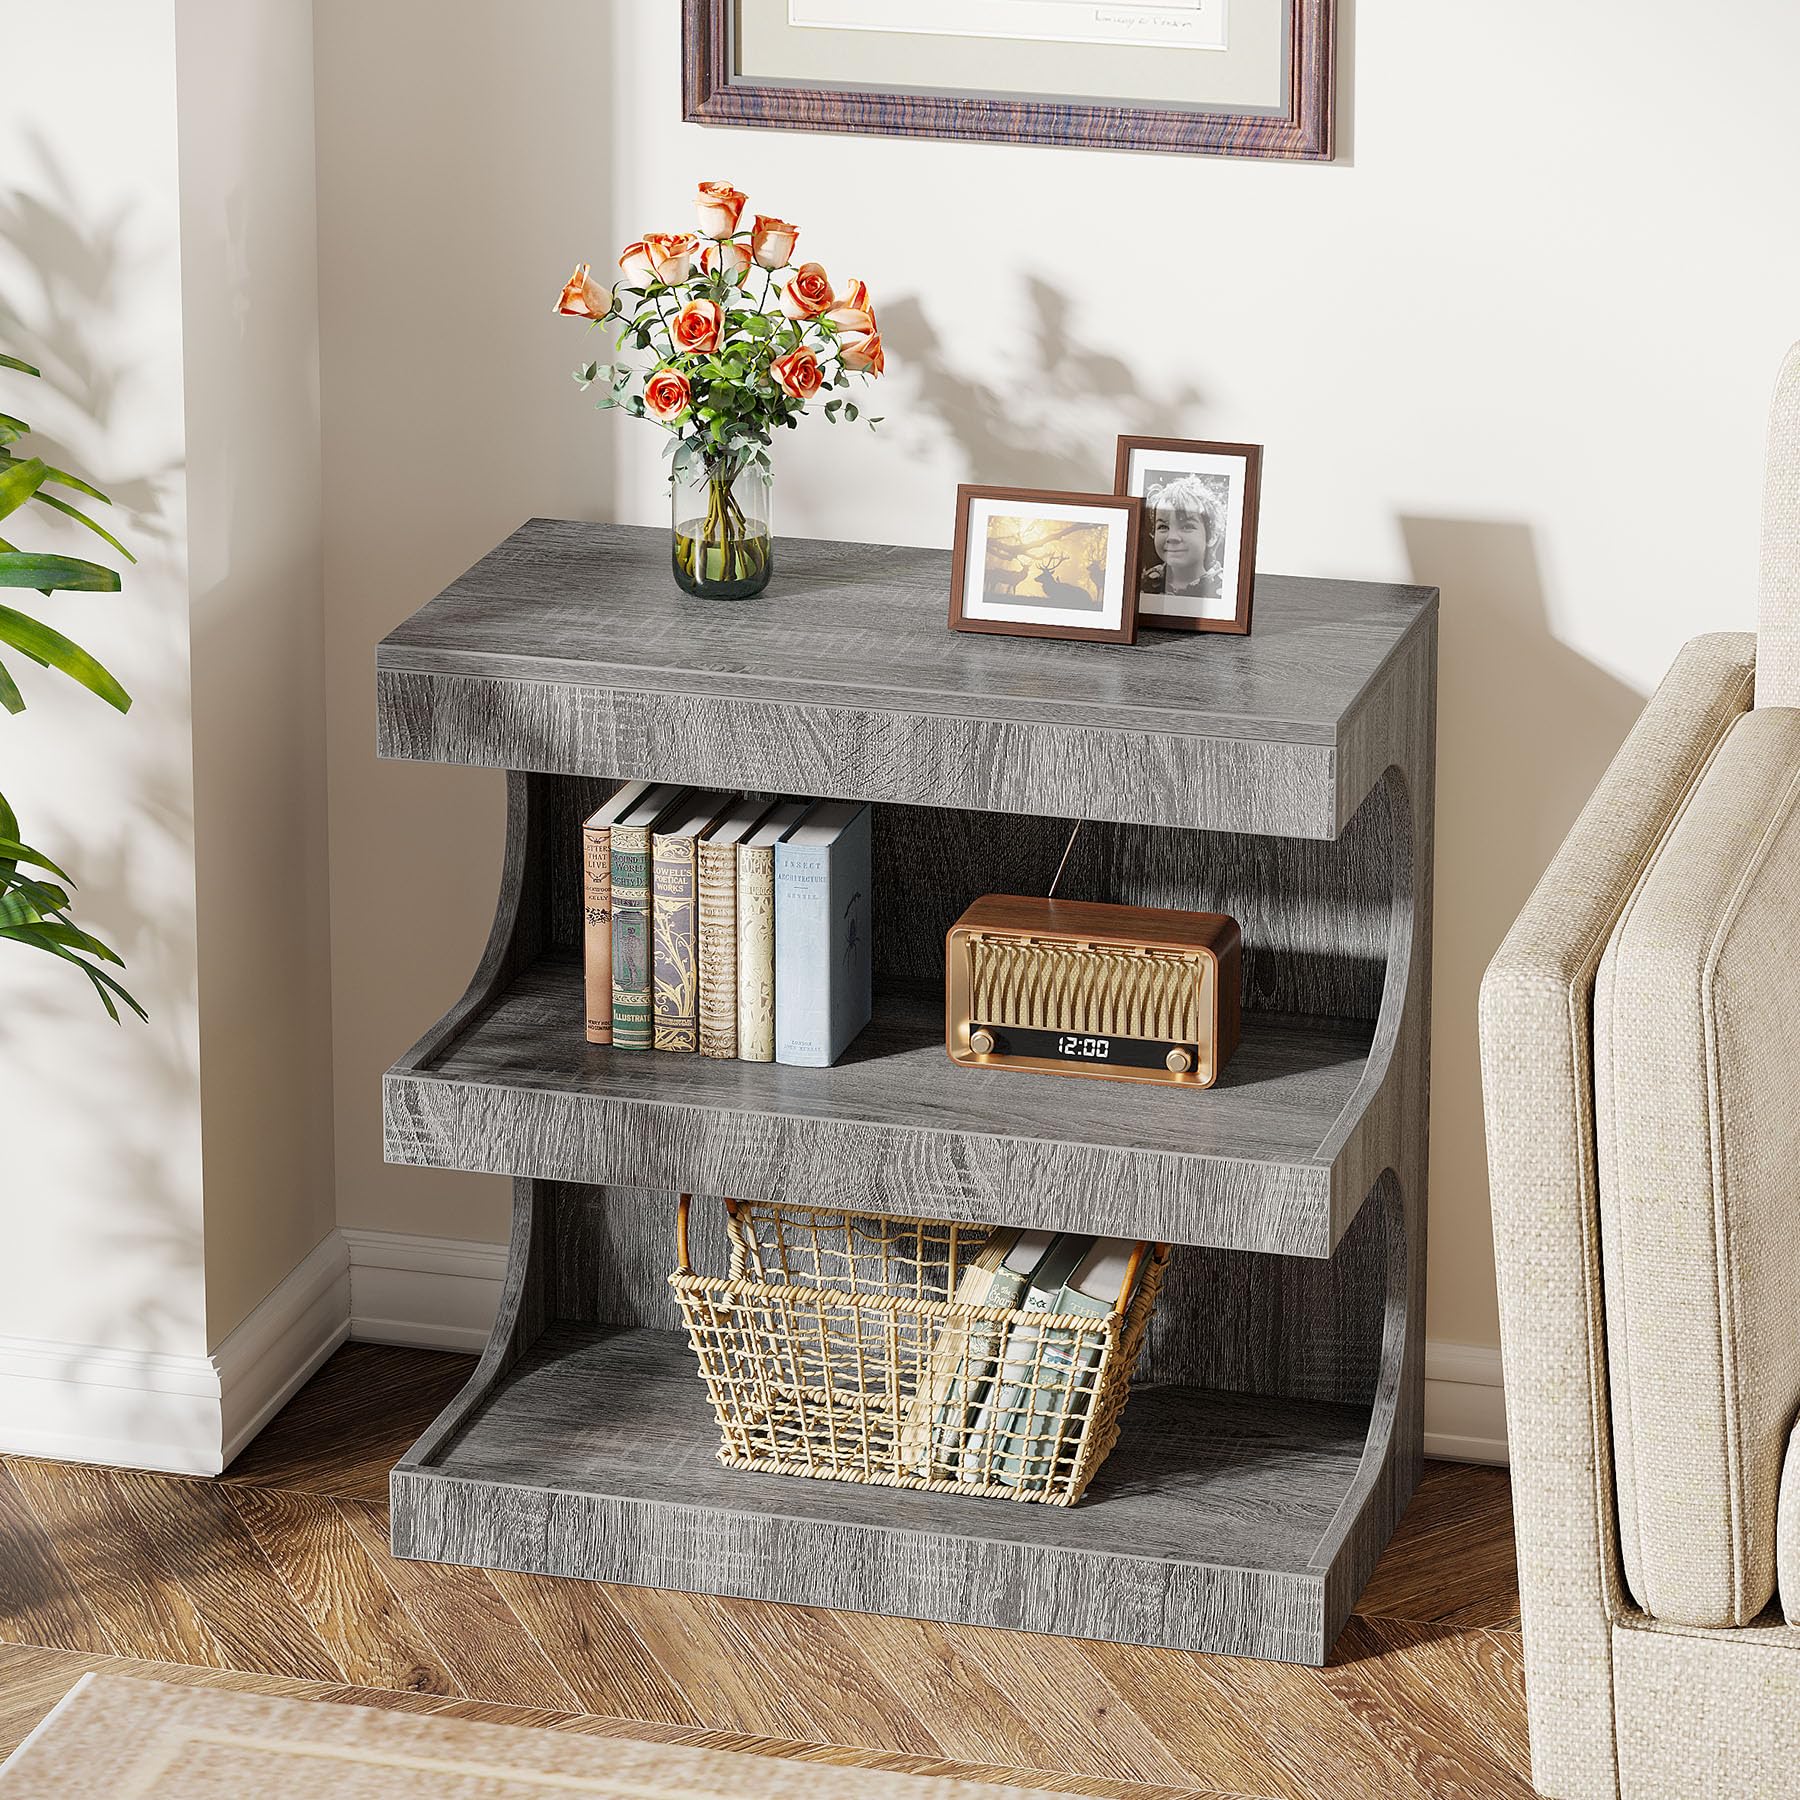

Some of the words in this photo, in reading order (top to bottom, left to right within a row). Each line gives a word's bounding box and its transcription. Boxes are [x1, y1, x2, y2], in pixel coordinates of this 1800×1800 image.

[585, 845, 611, 854] ETTERS
[588, 853, 607, 861] THAT
[612, 854, 638, 864] ROUND
[588, 860, 607, 869] LIVE
[615, 861, 646, 874] WORLD
[784, 860, 821, 869] INSECT
[656, 882, 684, 894] WORKS
[1059, 1036, 1109, 1058] 12:00
[1069, 1302, 1099, 1317] THE
